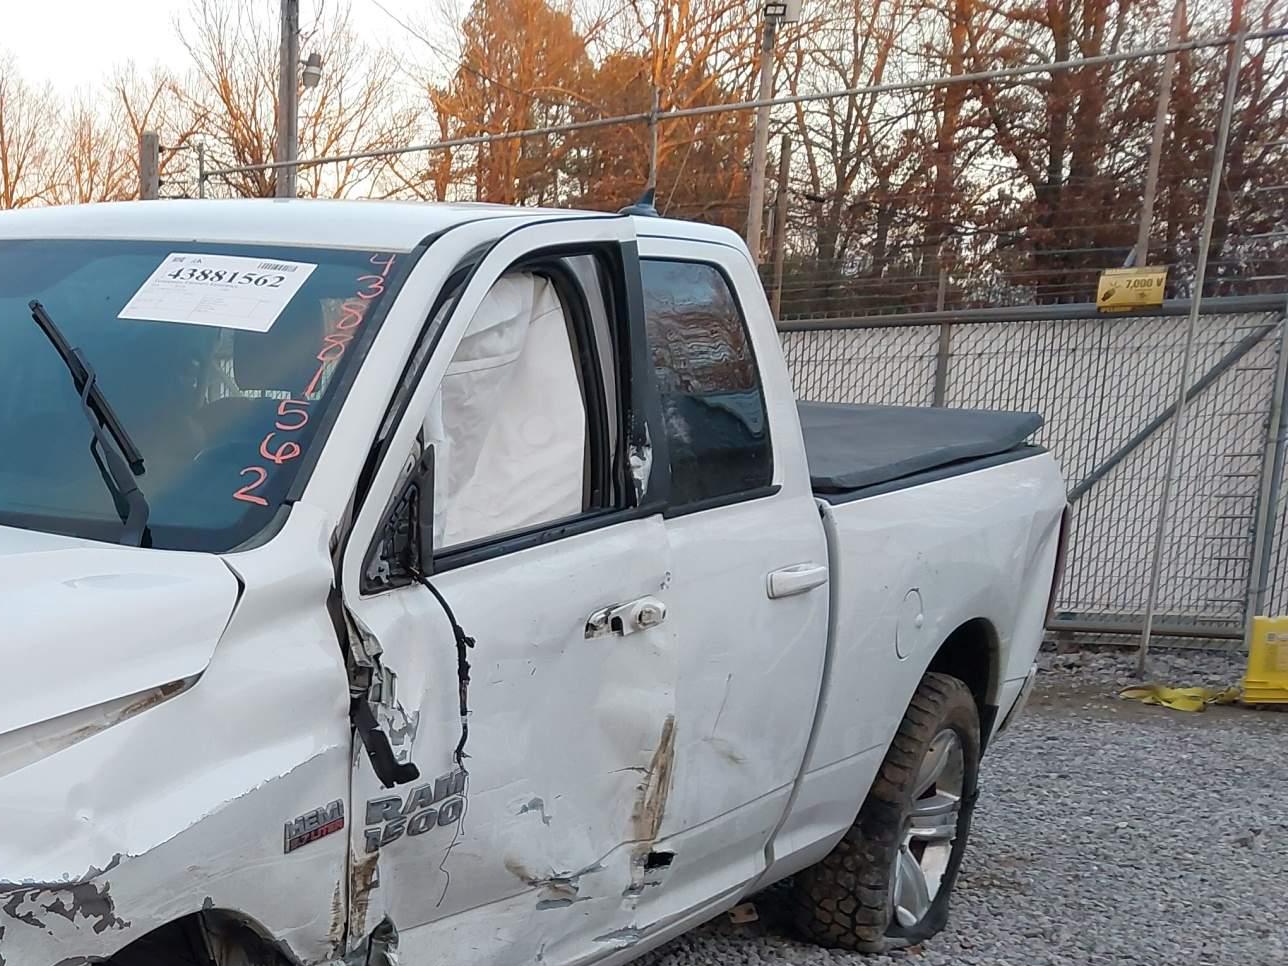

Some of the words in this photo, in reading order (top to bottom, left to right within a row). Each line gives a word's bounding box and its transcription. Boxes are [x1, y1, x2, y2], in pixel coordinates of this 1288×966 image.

[168, 267, 285, 289] 43881562
[365, 769, 466, 825] RAM
[364, 798, 464, 853] 1500
